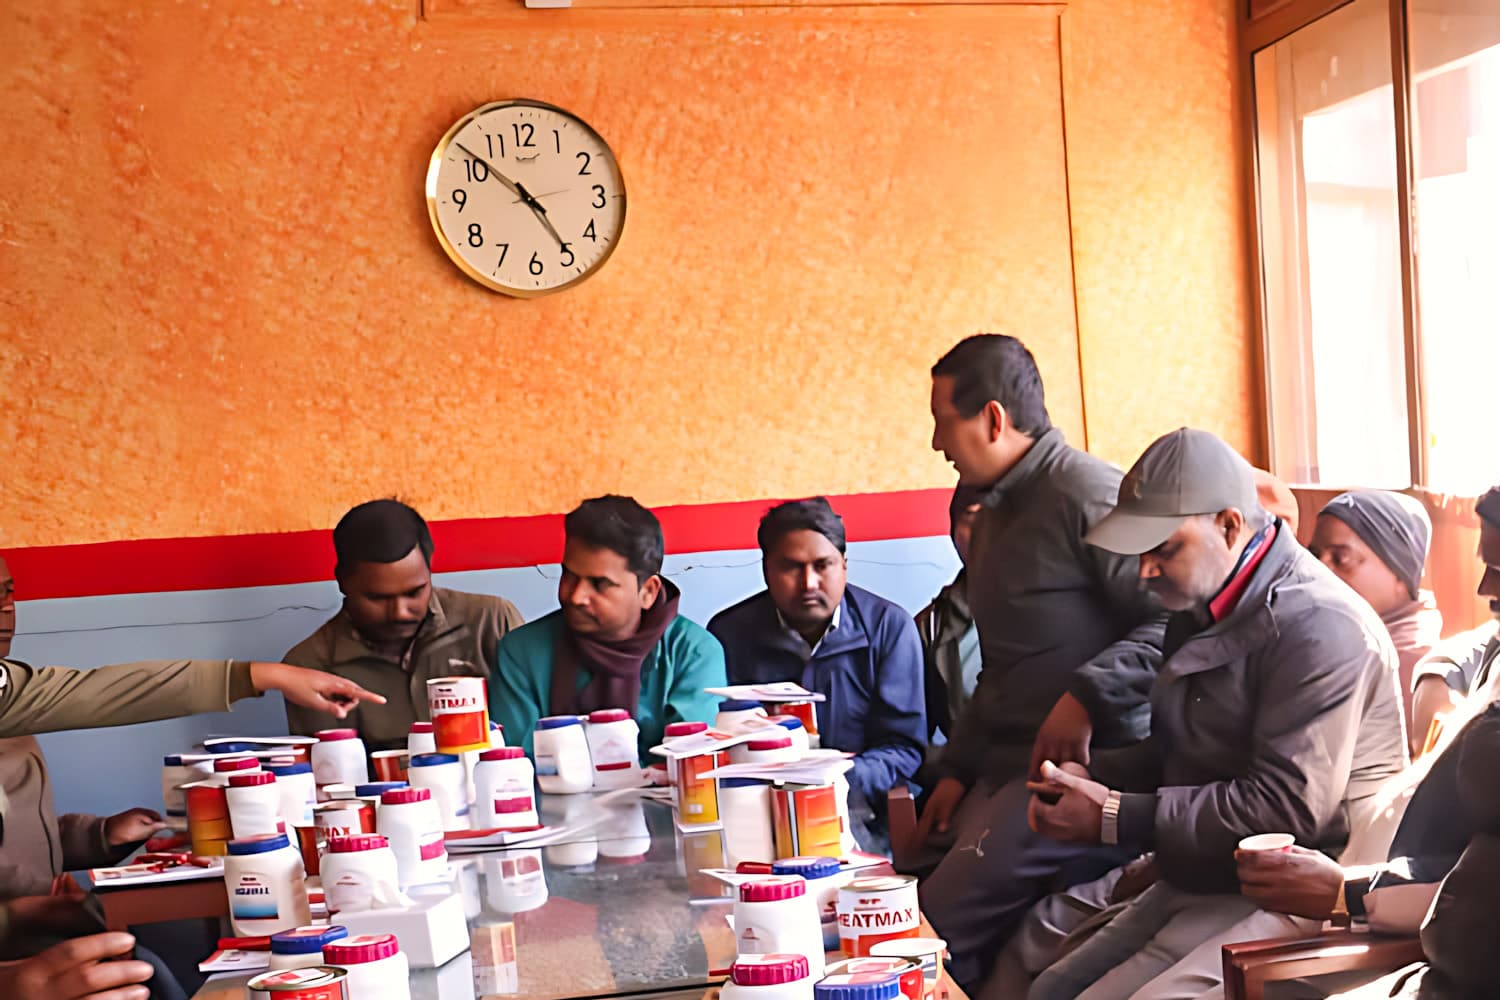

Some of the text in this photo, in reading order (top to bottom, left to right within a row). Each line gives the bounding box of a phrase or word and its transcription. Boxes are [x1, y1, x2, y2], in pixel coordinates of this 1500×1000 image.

[486, 134, 505, 158] 11
[512, 123, 536, 147] 12
[553, 130, 561, 154] 1
[464, 158, 488, 182] 10
[576, 152, 591, 175] 2
[452, 189, 467, 213] 9
[592, 184, 606, 209] 3
[468, 223, 483, 247] 8
[582, 218, 596, 242] 4
[496, 244, 509, 268] 7
[529, 251, 543, 275] 6
[560, 242, 575, 267] 5
[838, 908, 912, 928] EATMAX
